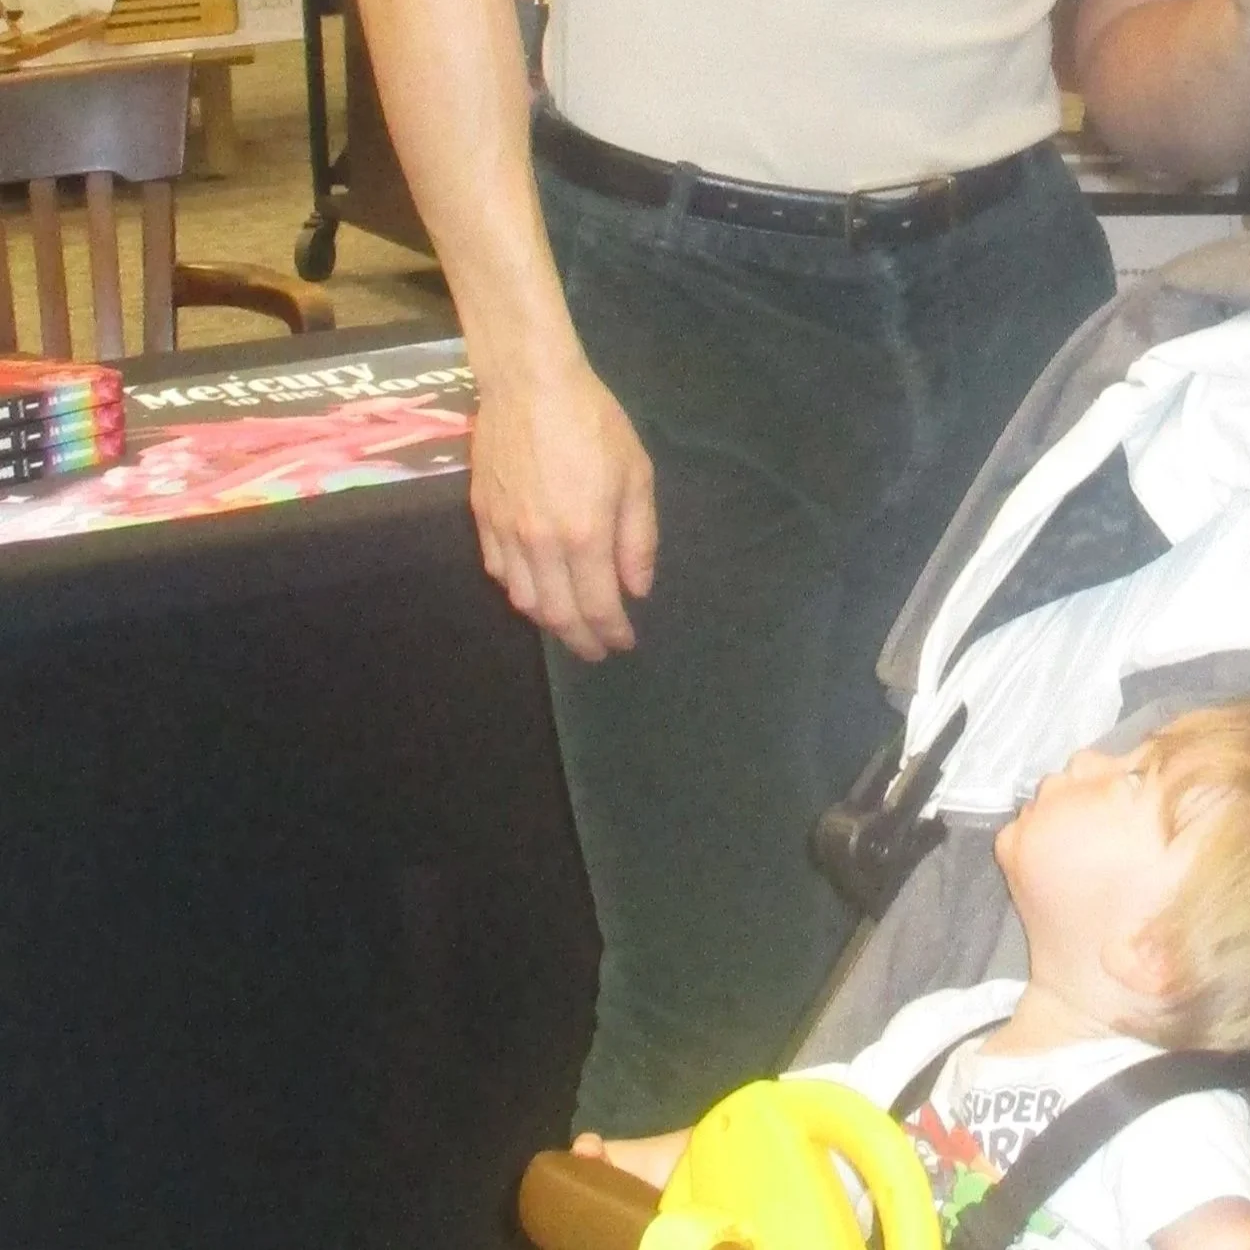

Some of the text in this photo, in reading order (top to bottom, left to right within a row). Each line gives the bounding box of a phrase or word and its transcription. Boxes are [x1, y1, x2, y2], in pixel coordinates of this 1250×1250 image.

[133, 361, 376, 411] Mercury
[223, 388, 324, 408] to the
[962, 1088, 1062, 1126] SUPER
